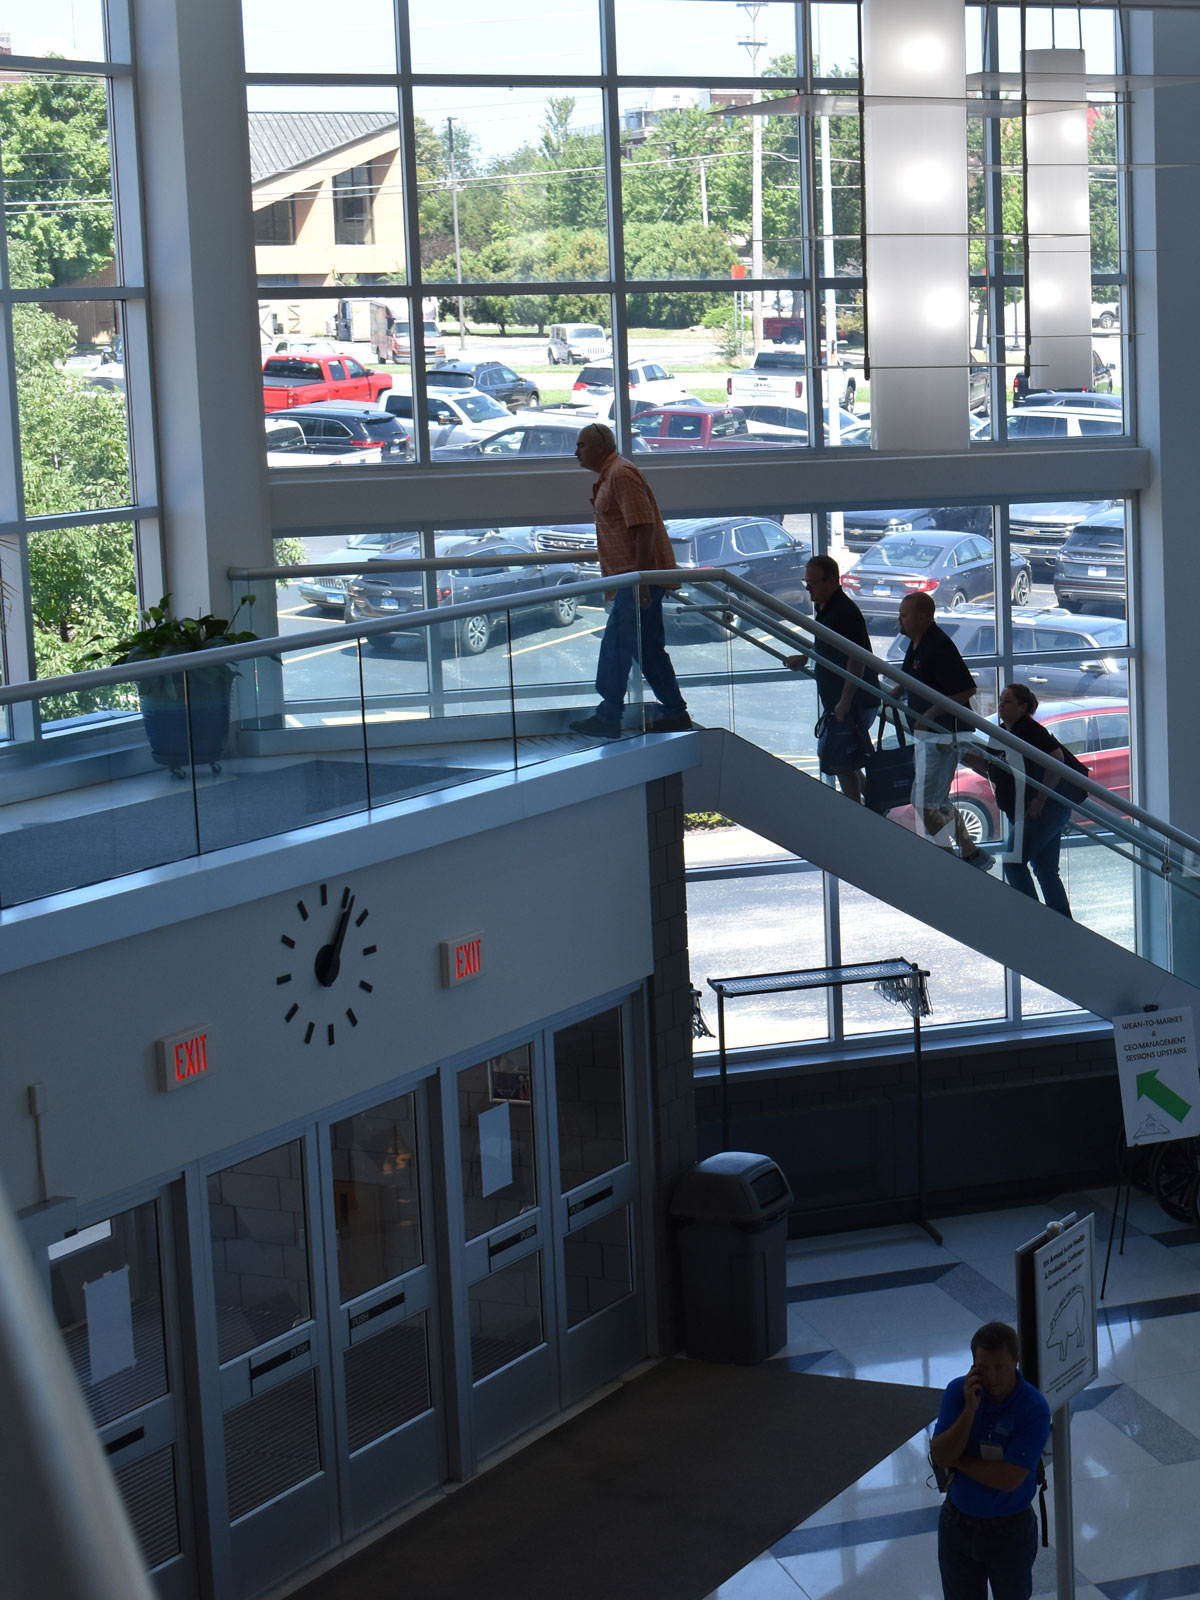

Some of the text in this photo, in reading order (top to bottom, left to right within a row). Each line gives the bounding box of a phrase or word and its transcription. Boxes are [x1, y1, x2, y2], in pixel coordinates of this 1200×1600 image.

[456, 939, 481, 979] EXIT
[1122, 1016, 1183, 1030] WEAN-TO-MARKET
[1124, 1037, 1186, 1051] CEO/MANAGEMENT
[174, 1034, 207, 1081] EXIT
[1125, 1047, 1188, 1062] SESSIONS UPSTAIRS
[520, 1225, 536, 1239] PUSH
[352, 1312, 369, 1326] PUSH
[290, 1342, 308, 1358] PUSH
